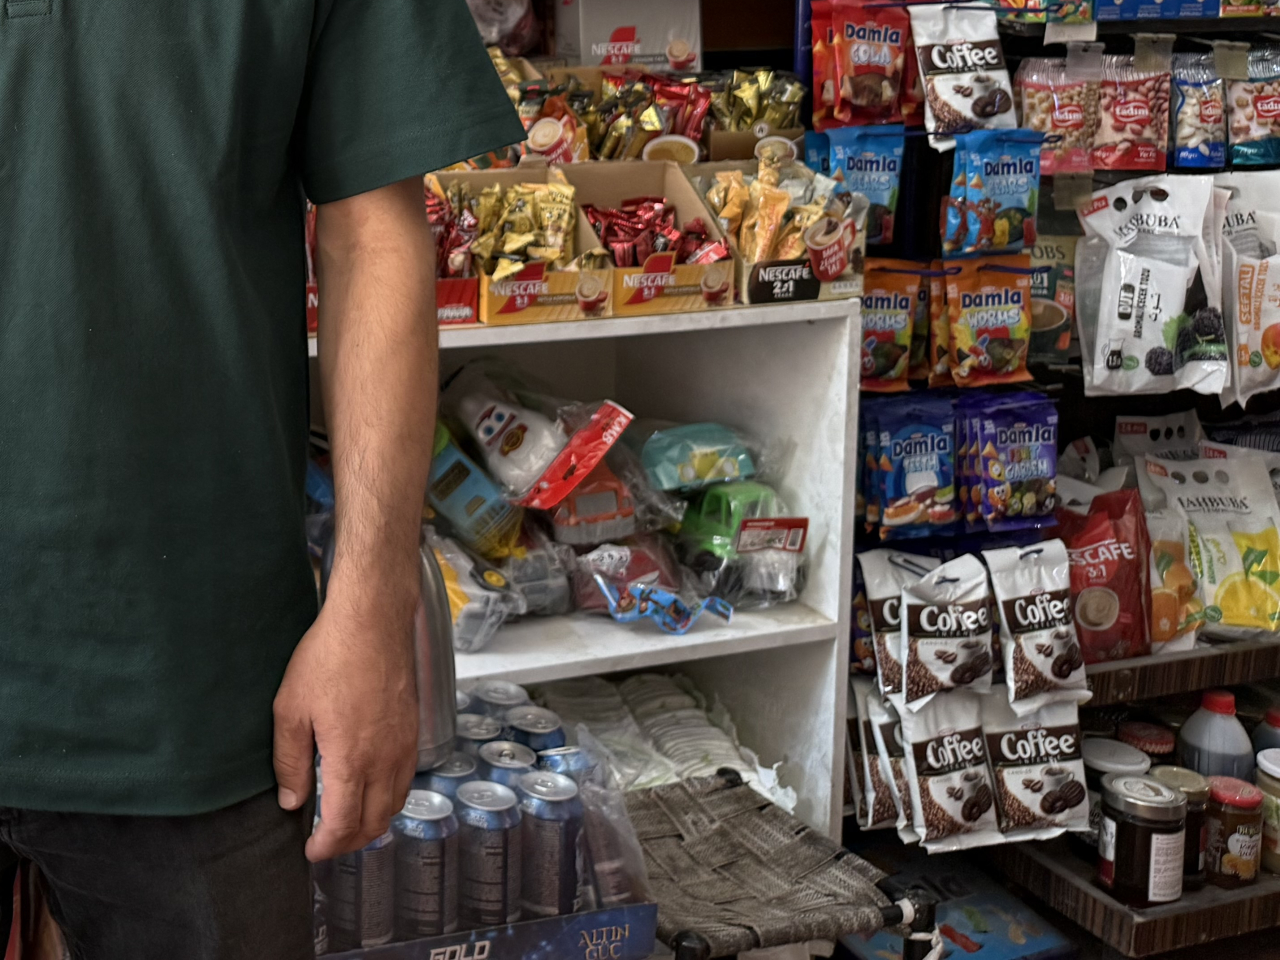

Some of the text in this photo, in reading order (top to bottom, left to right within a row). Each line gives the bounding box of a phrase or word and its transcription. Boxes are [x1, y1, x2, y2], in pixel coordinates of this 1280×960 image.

[844, 24, 901, 44] Damla
[850, 43, 892, 65] COLA
[931, 42, 998, 71] Coffee
[846, 155, 898, 174] Damla
[984, 157, 1034, 177] Damla
[962, 289, 1022, 308] Damla
[968, 308, 1022, 328] WORMS
[892, 435, 948, 458] Damla
[997, 426, 1054, 446] Damla
[920, 604, 988, 632] Coffee
[926, 732, 984, 770] Coffee
[1000, 730, 1075, 760] Coffee
[578, 924, 630, 948] ALTIN
